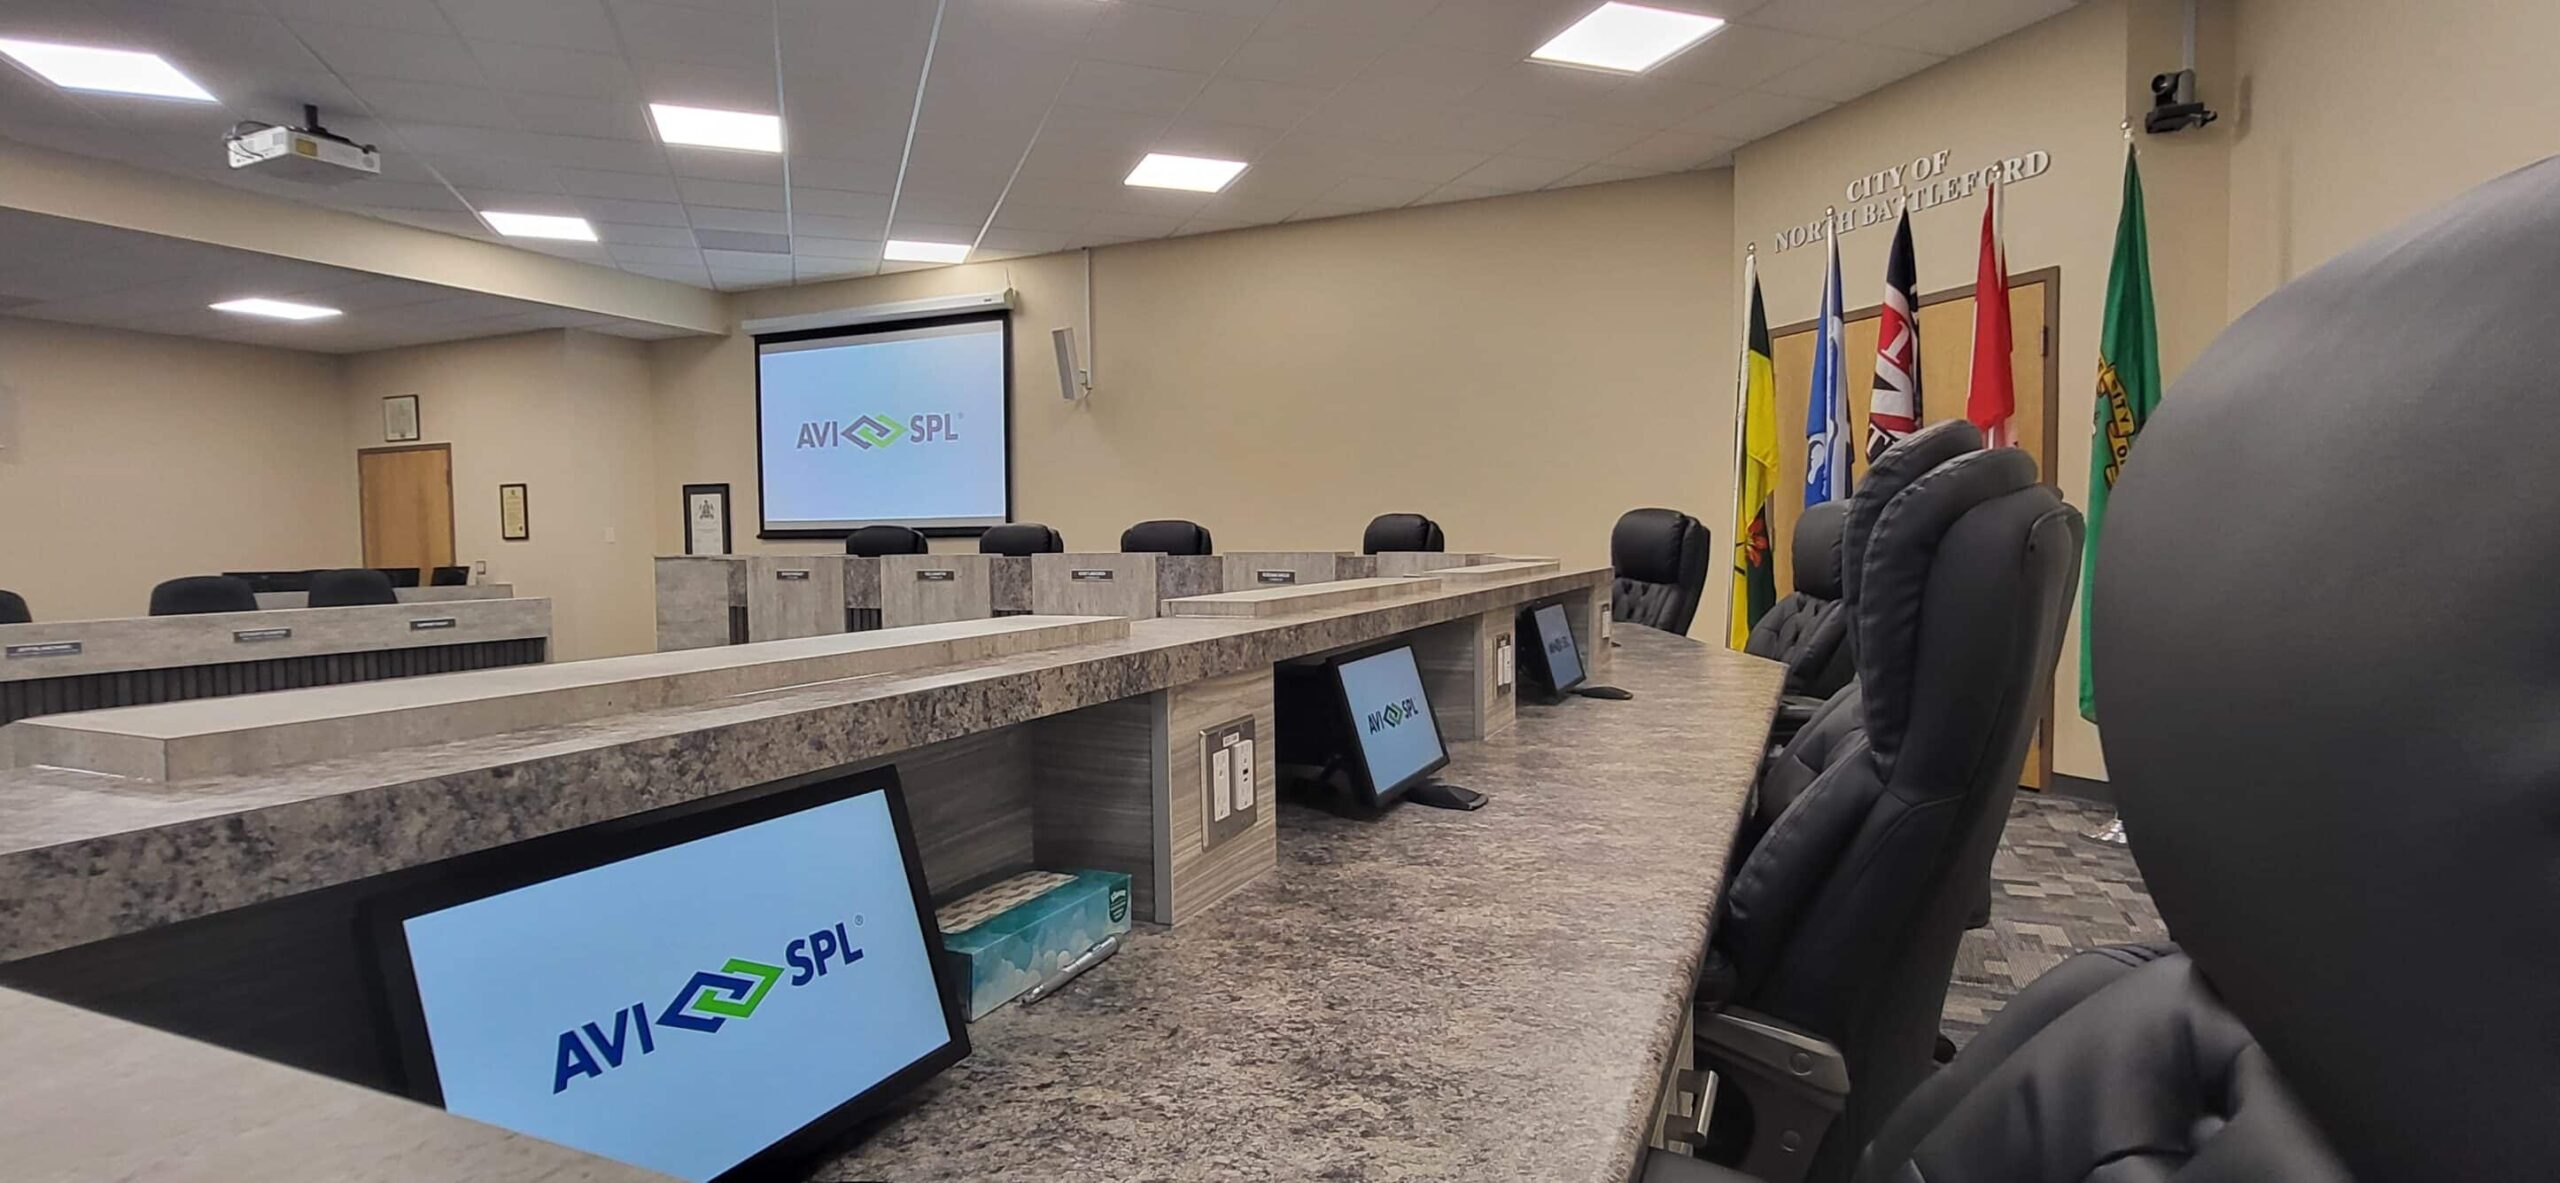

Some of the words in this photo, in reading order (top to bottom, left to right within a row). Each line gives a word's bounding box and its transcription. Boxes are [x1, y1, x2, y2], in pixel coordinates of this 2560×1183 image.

[1846, 163, 1907, 203] CITY
[1911, 149, 1951, 181] OF
[1775, 208, 1856, 254] NORH
[797, 421, 838, 449] AVI
[1367, 711, 1385, 735] AVI
[553, 1002, 655, 1095] AVI
